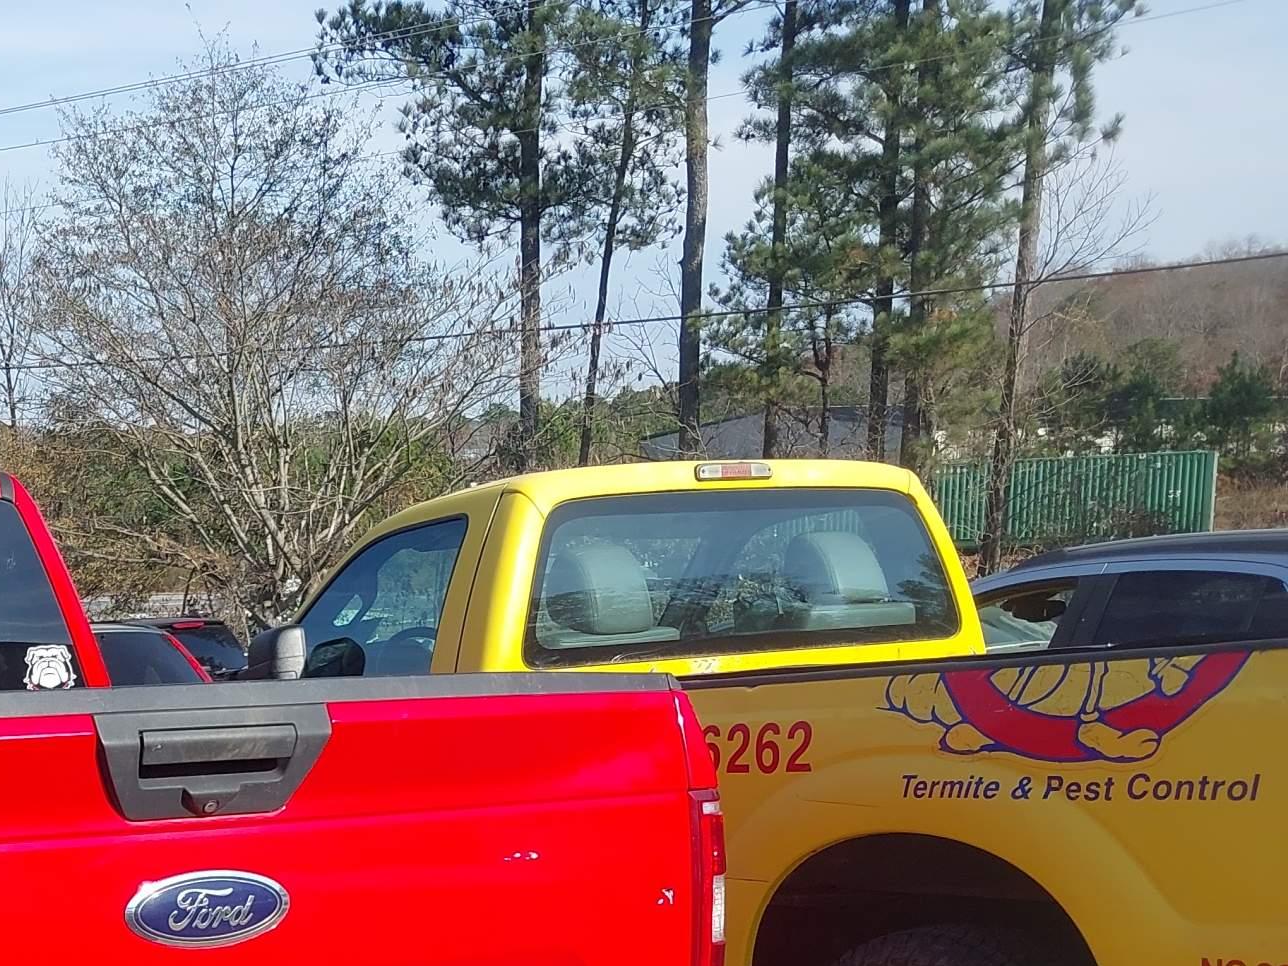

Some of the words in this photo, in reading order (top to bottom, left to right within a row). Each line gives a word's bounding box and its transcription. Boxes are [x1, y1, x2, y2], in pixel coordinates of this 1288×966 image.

[901, 774, 1000, 800] Termite
[1011, 776, 1033, 800] &
[1042, 775, 1115, 801] Pest
[1127, 773, 1261, 801] Control
[167, 887, 255, 932] Ford
